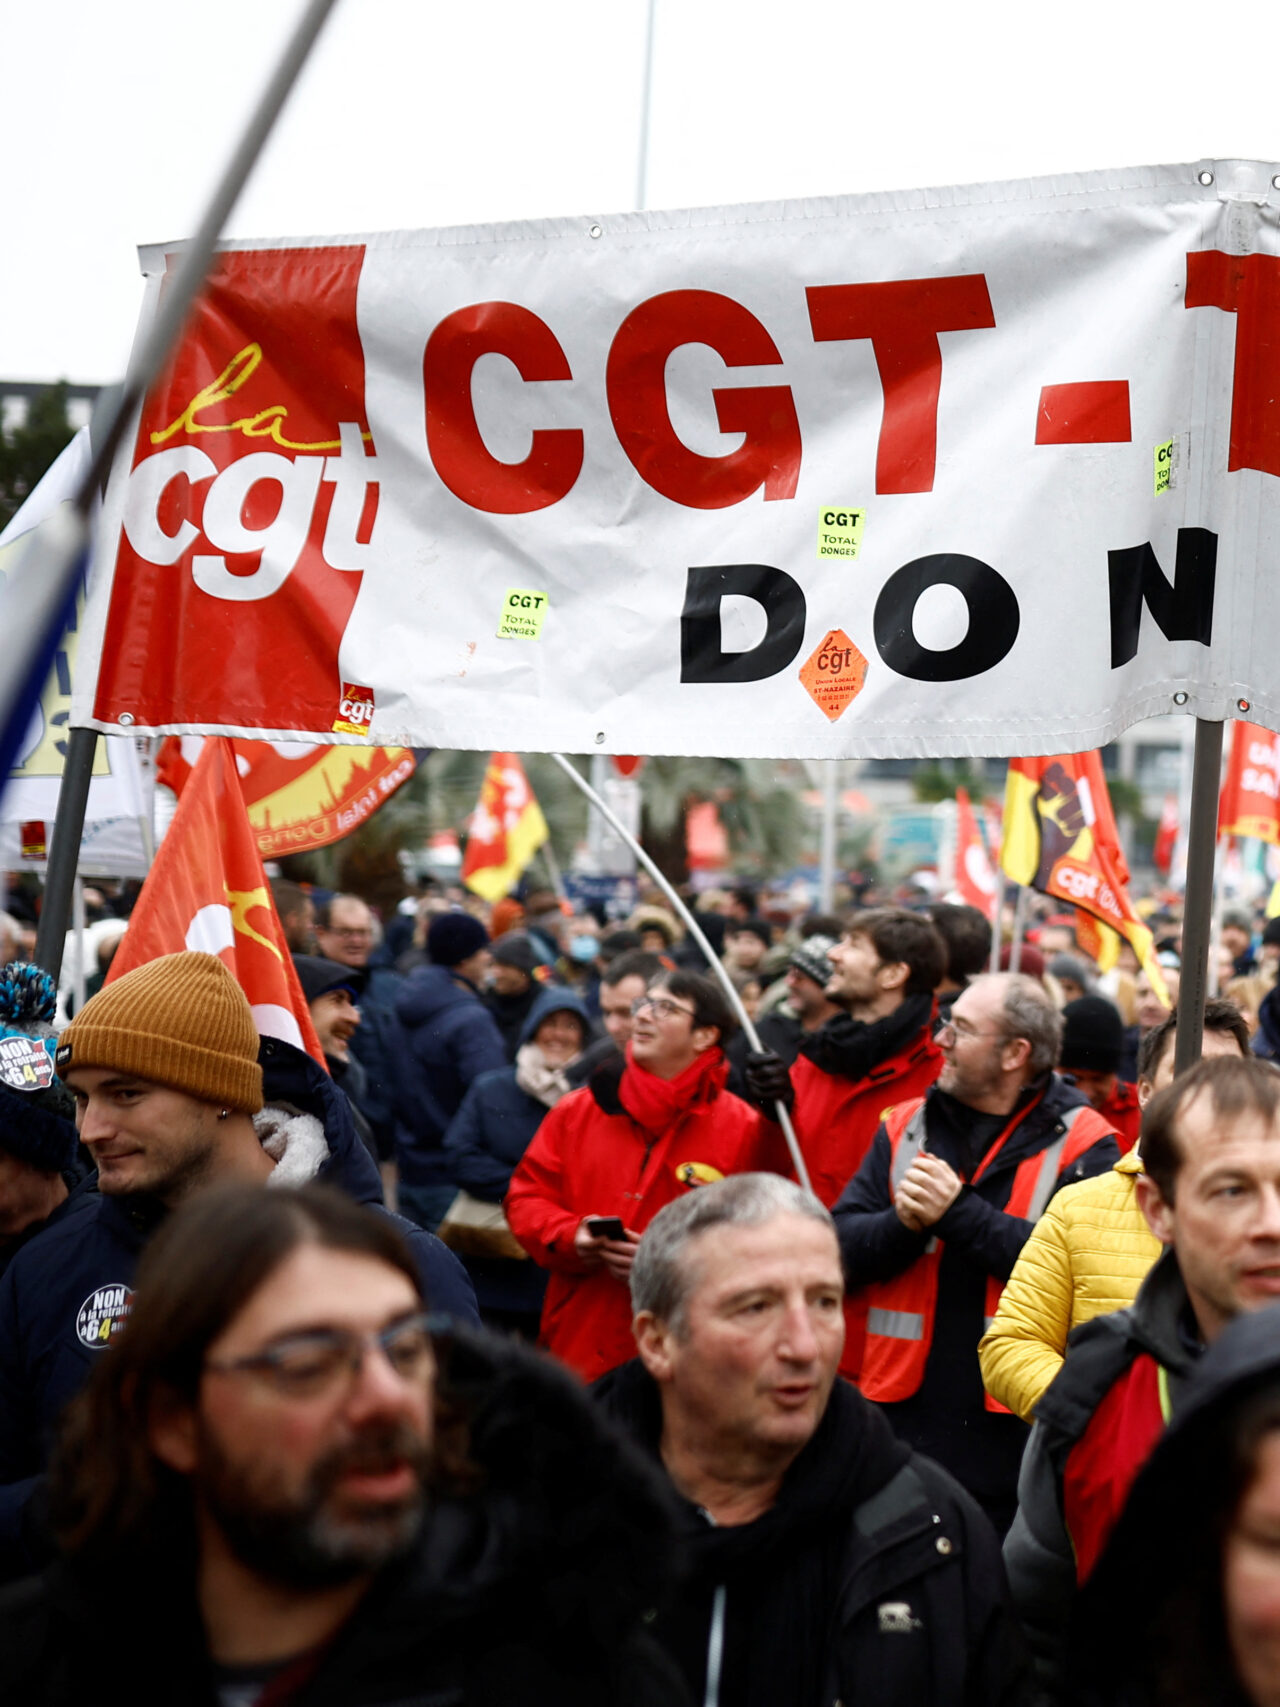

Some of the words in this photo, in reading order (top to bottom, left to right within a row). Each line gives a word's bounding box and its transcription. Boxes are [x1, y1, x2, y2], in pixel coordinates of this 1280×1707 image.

[122, 422, 380, 601] cgt
[823, 511, 860, 527] CGT
[822, 534, 857, 545] TOTAL
[820, 546, 856, 556] DONGES
[509, 594, 544, 609] CGT
[505, 614, 538, 626] TOTAL
[817, 648, 852, 675] cgt
[339, 699, 375, 724] cgt
[0, 1039, 33, 1060] NON
[92, 1287, 126, 1311] NON
